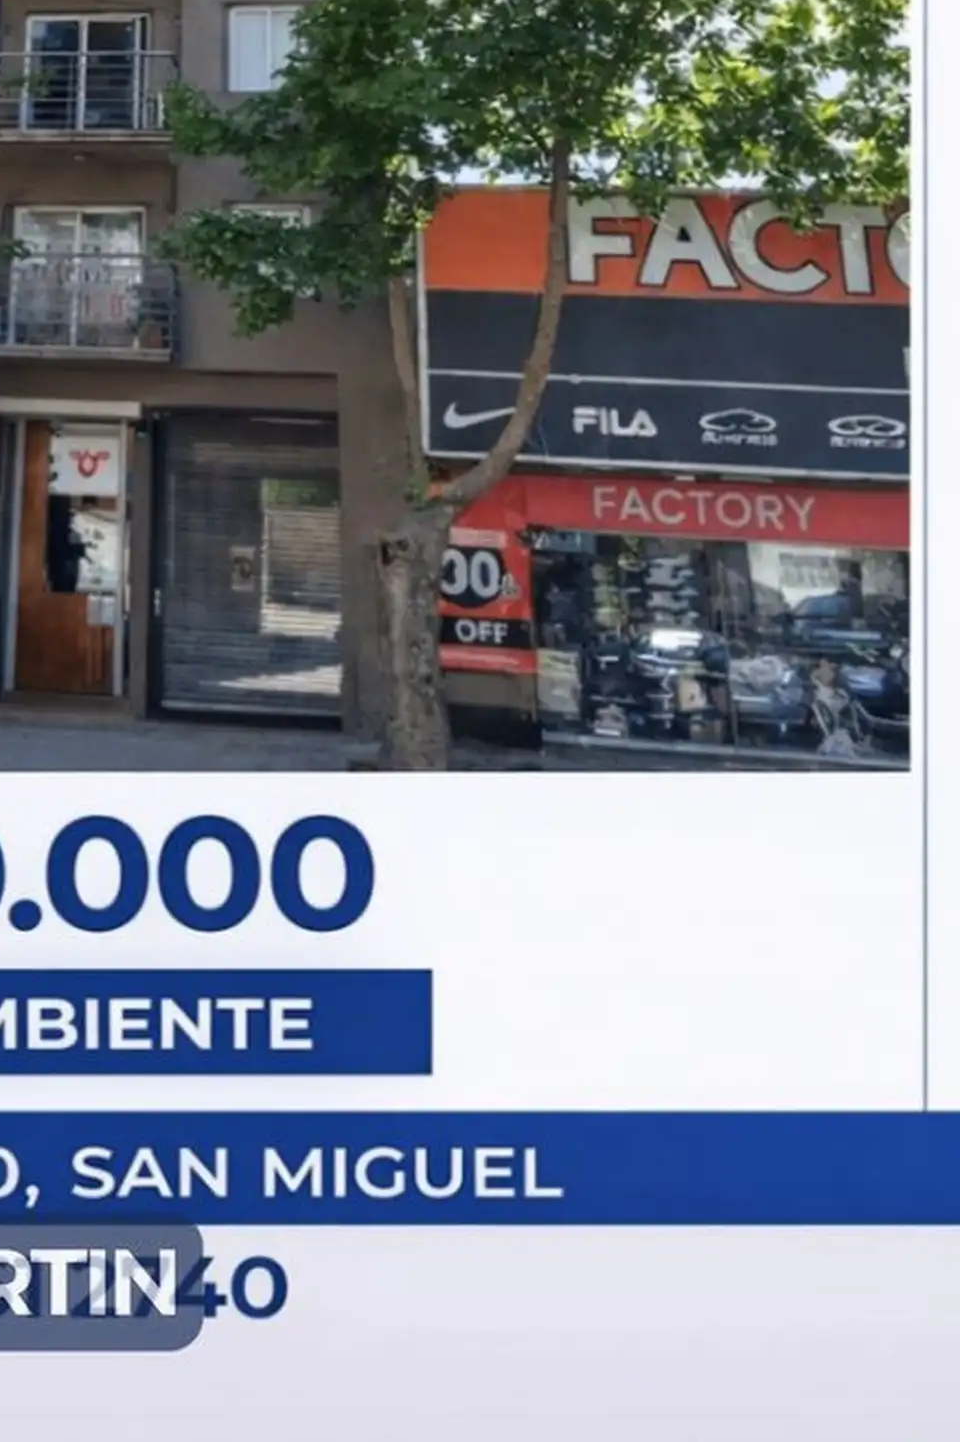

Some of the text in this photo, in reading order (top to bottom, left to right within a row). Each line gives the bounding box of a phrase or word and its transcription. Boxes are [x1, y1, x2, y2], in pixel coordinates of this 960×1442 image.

[567, 190, 911, 299] FACT
[573, 406, 658, 437] FILA
[592, 485, 816, 532] FACTORY
[454, 618, 510, 645] OFF
